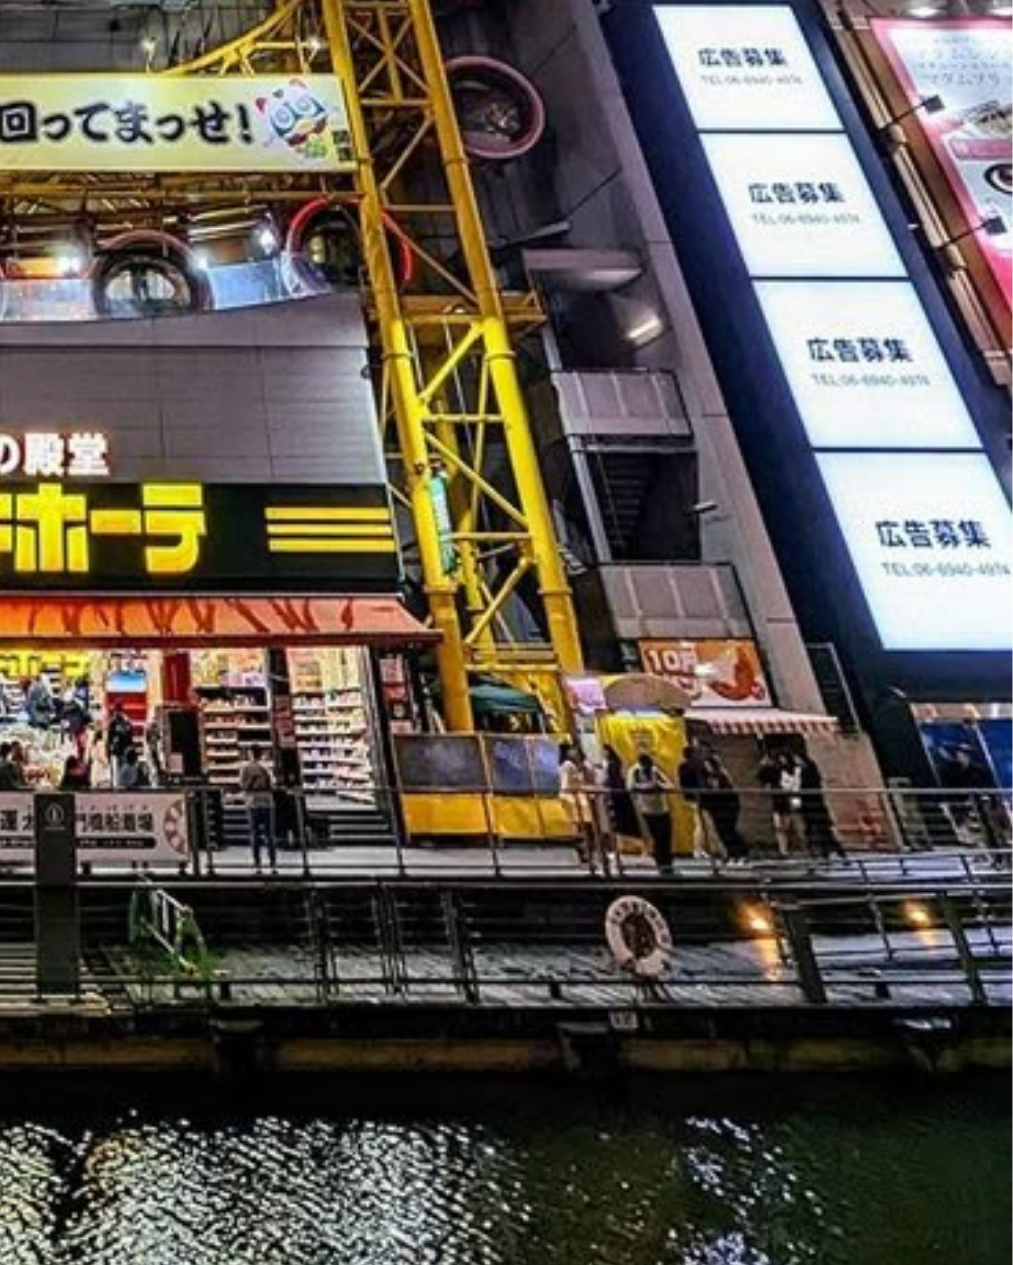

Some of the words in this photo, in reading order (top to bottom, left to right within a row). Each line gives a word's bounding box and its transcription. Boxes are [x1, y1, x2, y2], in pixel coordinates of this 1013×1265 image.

[697, 46, 788, 68] 広告募集
[747, 181, 846, 205] 広告募集
[805, 336, 915, 364] 広告募集
[873, 518, 992, 549] 広告募集
